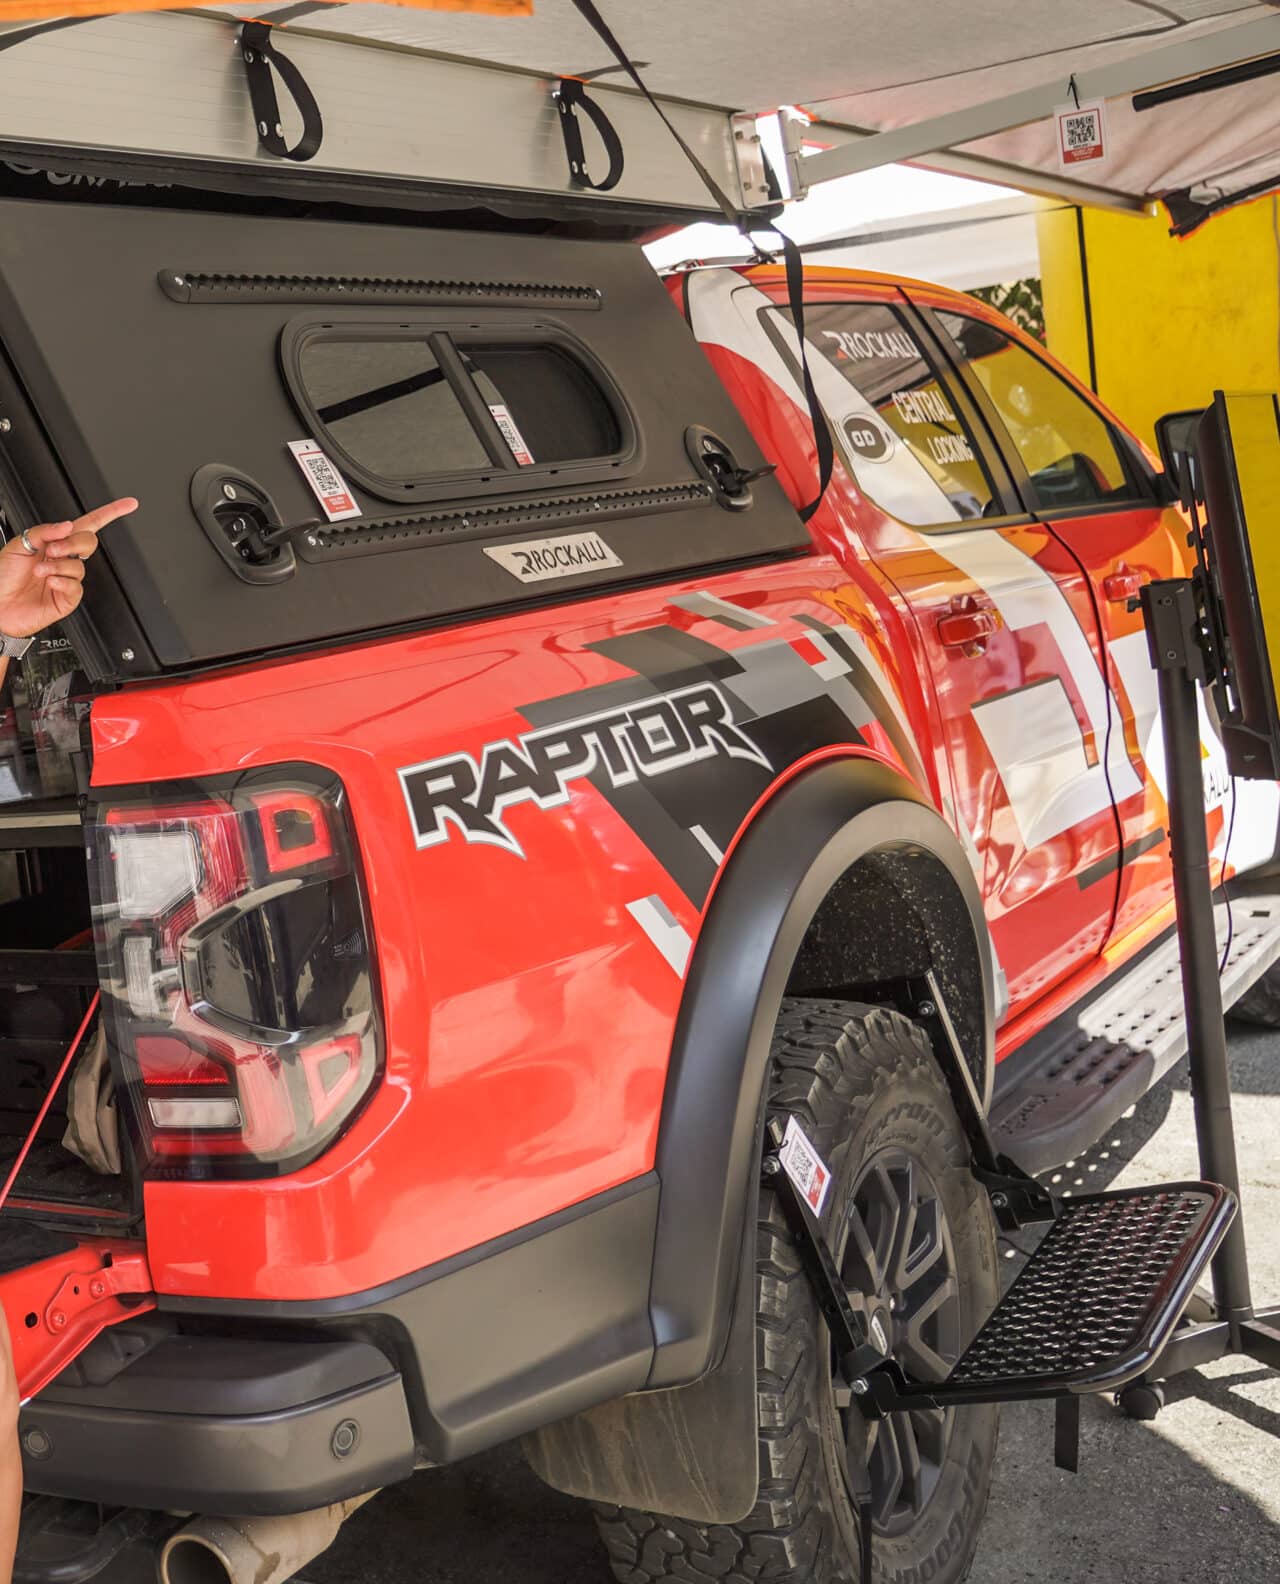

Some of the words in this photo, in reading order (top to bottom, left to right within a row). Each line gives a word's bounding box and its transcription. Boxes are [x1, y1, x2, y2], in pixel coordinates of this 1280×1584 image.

[892, 391, 957, 424] CENTRAL
[926, 433, 975, 465] LOCKING
[397, 681, 775, 860] RAPTOR
